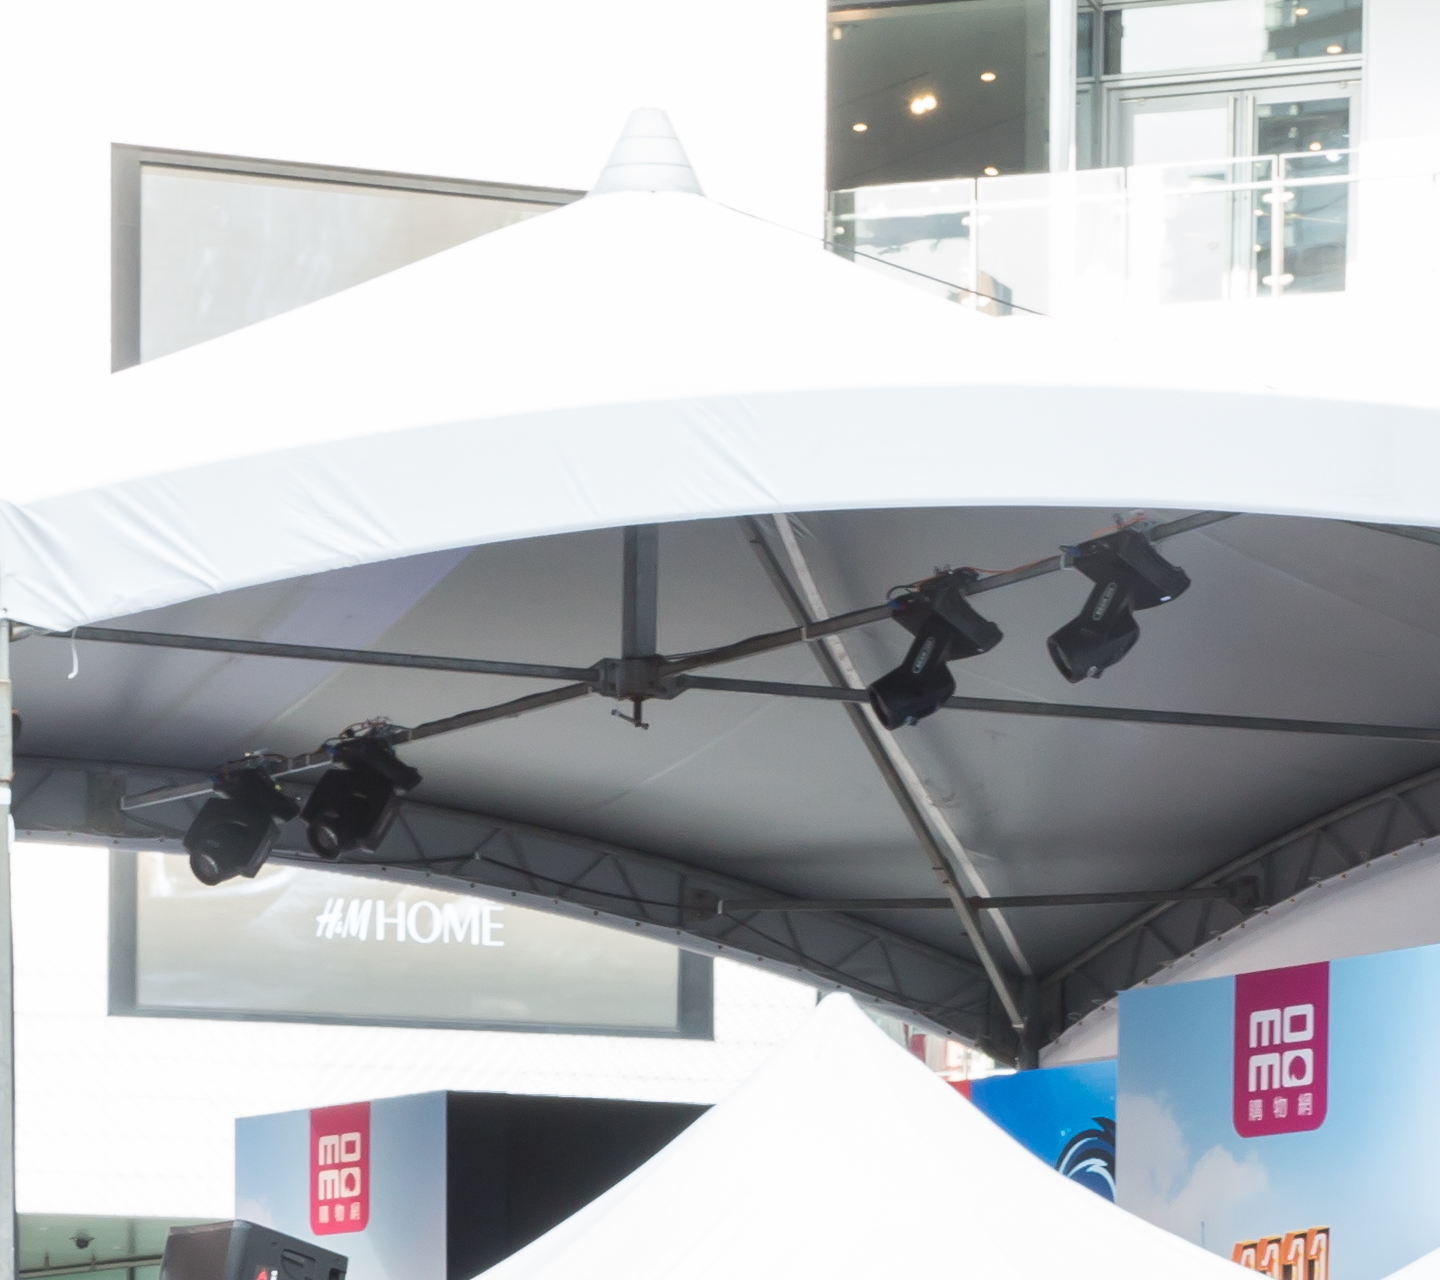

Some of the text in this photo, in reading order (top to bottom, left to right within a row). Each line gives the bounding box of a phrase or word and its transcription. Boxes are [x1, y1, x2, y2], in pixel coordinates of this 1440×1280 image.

[316, 898, 505, 947] H&M HOME
[1248, 1092, 1313, 1121] 購物網
